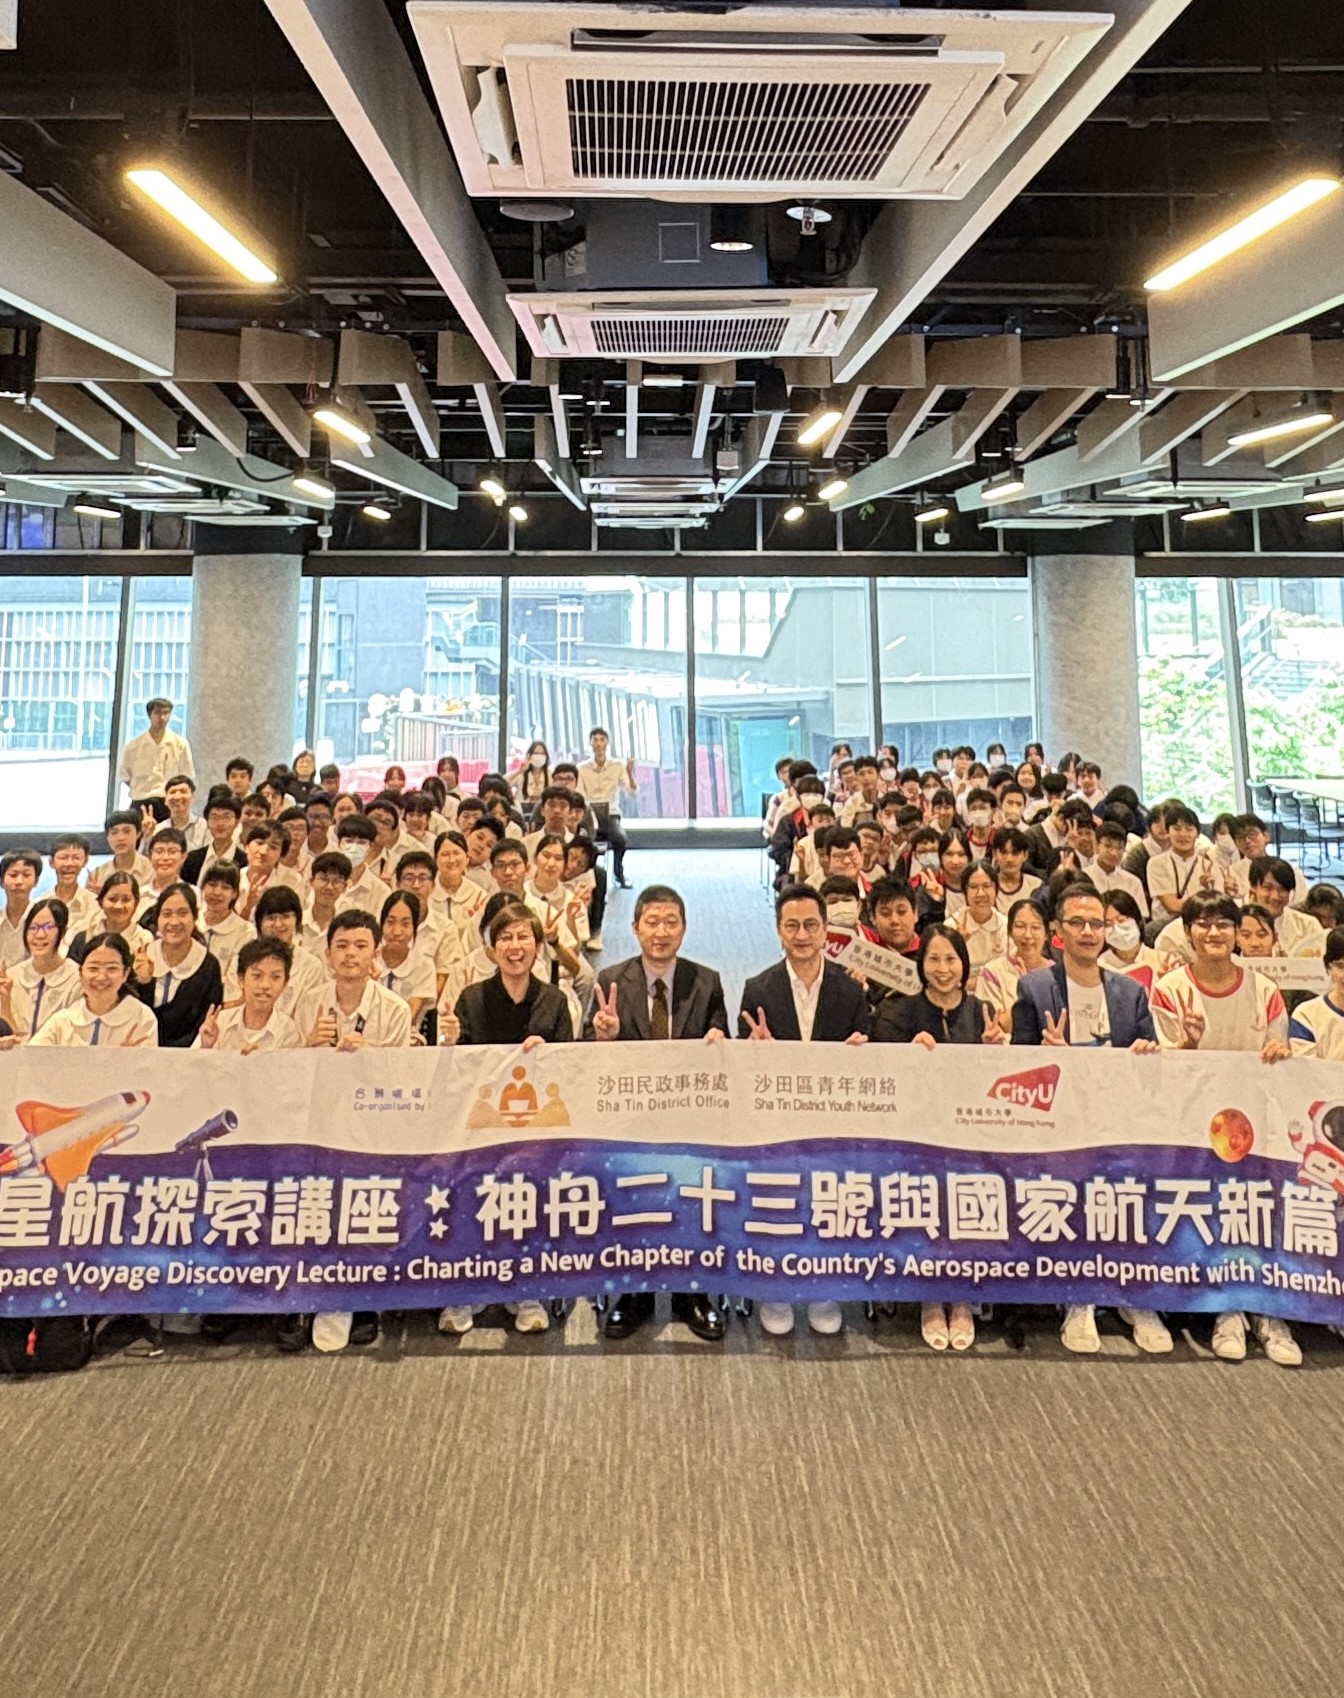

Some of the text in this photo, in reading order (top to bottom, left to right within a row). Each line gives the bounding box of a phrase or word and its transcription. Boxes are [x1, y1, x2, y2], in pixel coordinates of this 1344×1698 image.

[597, 1072, 729, 1095] 沙田民政事務處
[754, 1074, 896, 1096] 沙田區青年網絡
[996, 1082, 1054, 1107] CityU
[596, 1095, 730, 1112] Sha Tin District Office
[754, 1098, 897, 1113] Sha Tin District Youth Network
[64, 1261, 161, 1292] Voyage
[167, 1259, 291, 1291] Discovery
[297, 1260, 388, 1283] Lecture
[393, 1265, 401, 1281] :
[407, 1255, 514, 1282] Charting
[520, 1256, 533, 1274] a
[540, 1251, 594, 1273] New
[600, 1244, 694, 1271] Chapter
[700, 1245, 725, 1268] of
[736, 1247, 775, 1275] the
[782, 1252, 896, 1281] Country's
[902, 1254, 1030, 1283] Aerospace
[1036, 1253, 1200, 1286] Development
[1206, 1257, 1256, 1284] with
